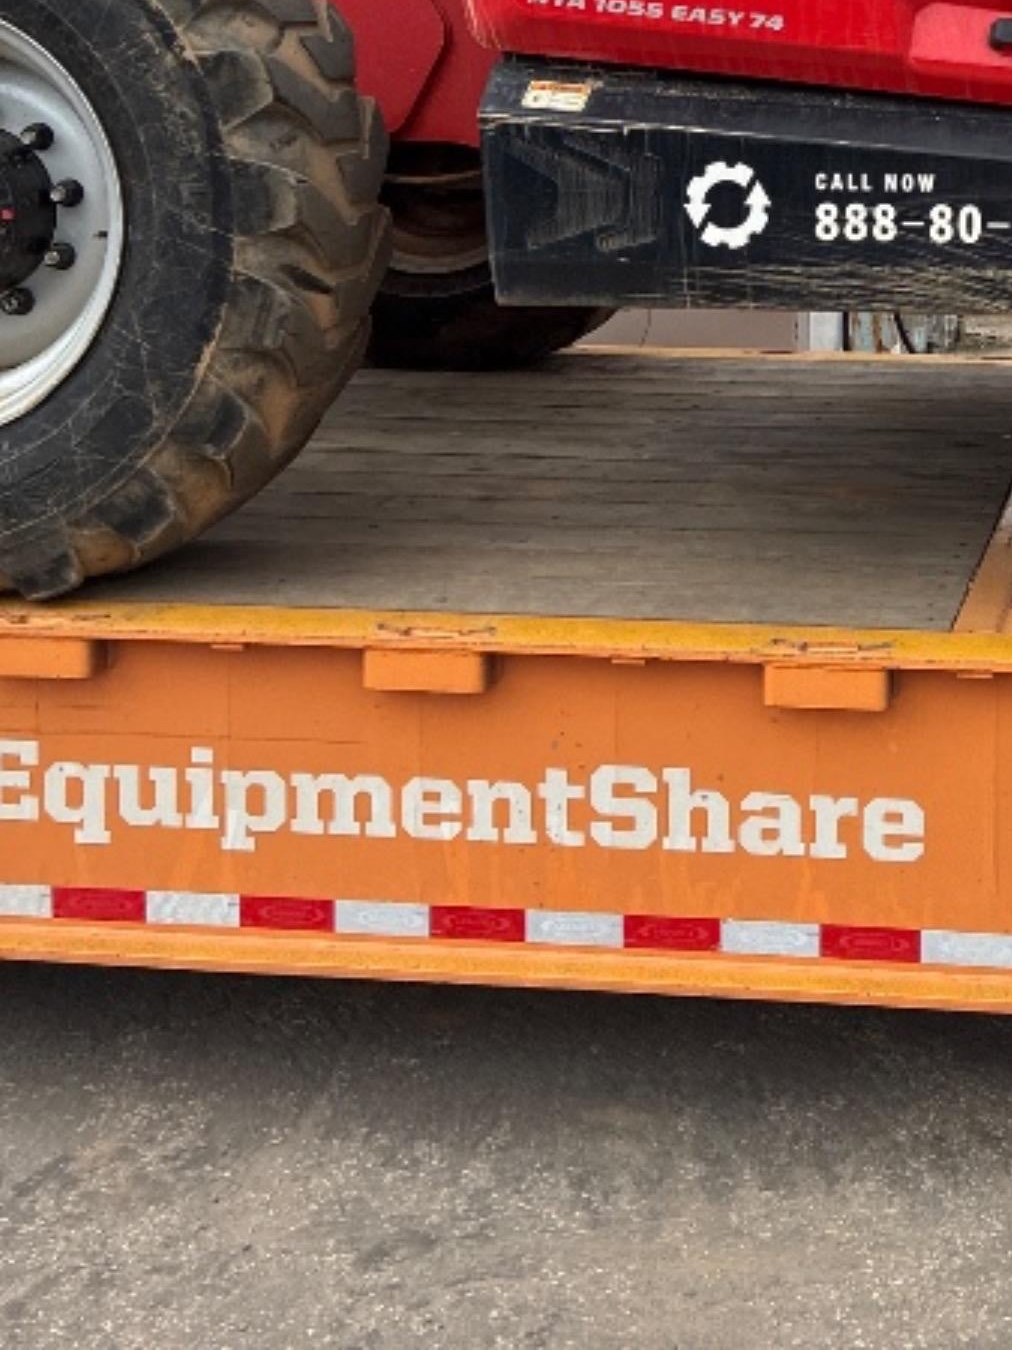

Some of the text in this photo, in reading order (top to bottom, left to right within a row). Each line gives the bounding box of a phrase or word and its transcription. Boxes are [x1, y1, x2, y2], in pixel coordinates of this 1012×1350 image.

[670, 5, 745, 27] EASY
[749, 12, 785, 31] 74
[814, 172, 936, 193] CALL NOW
